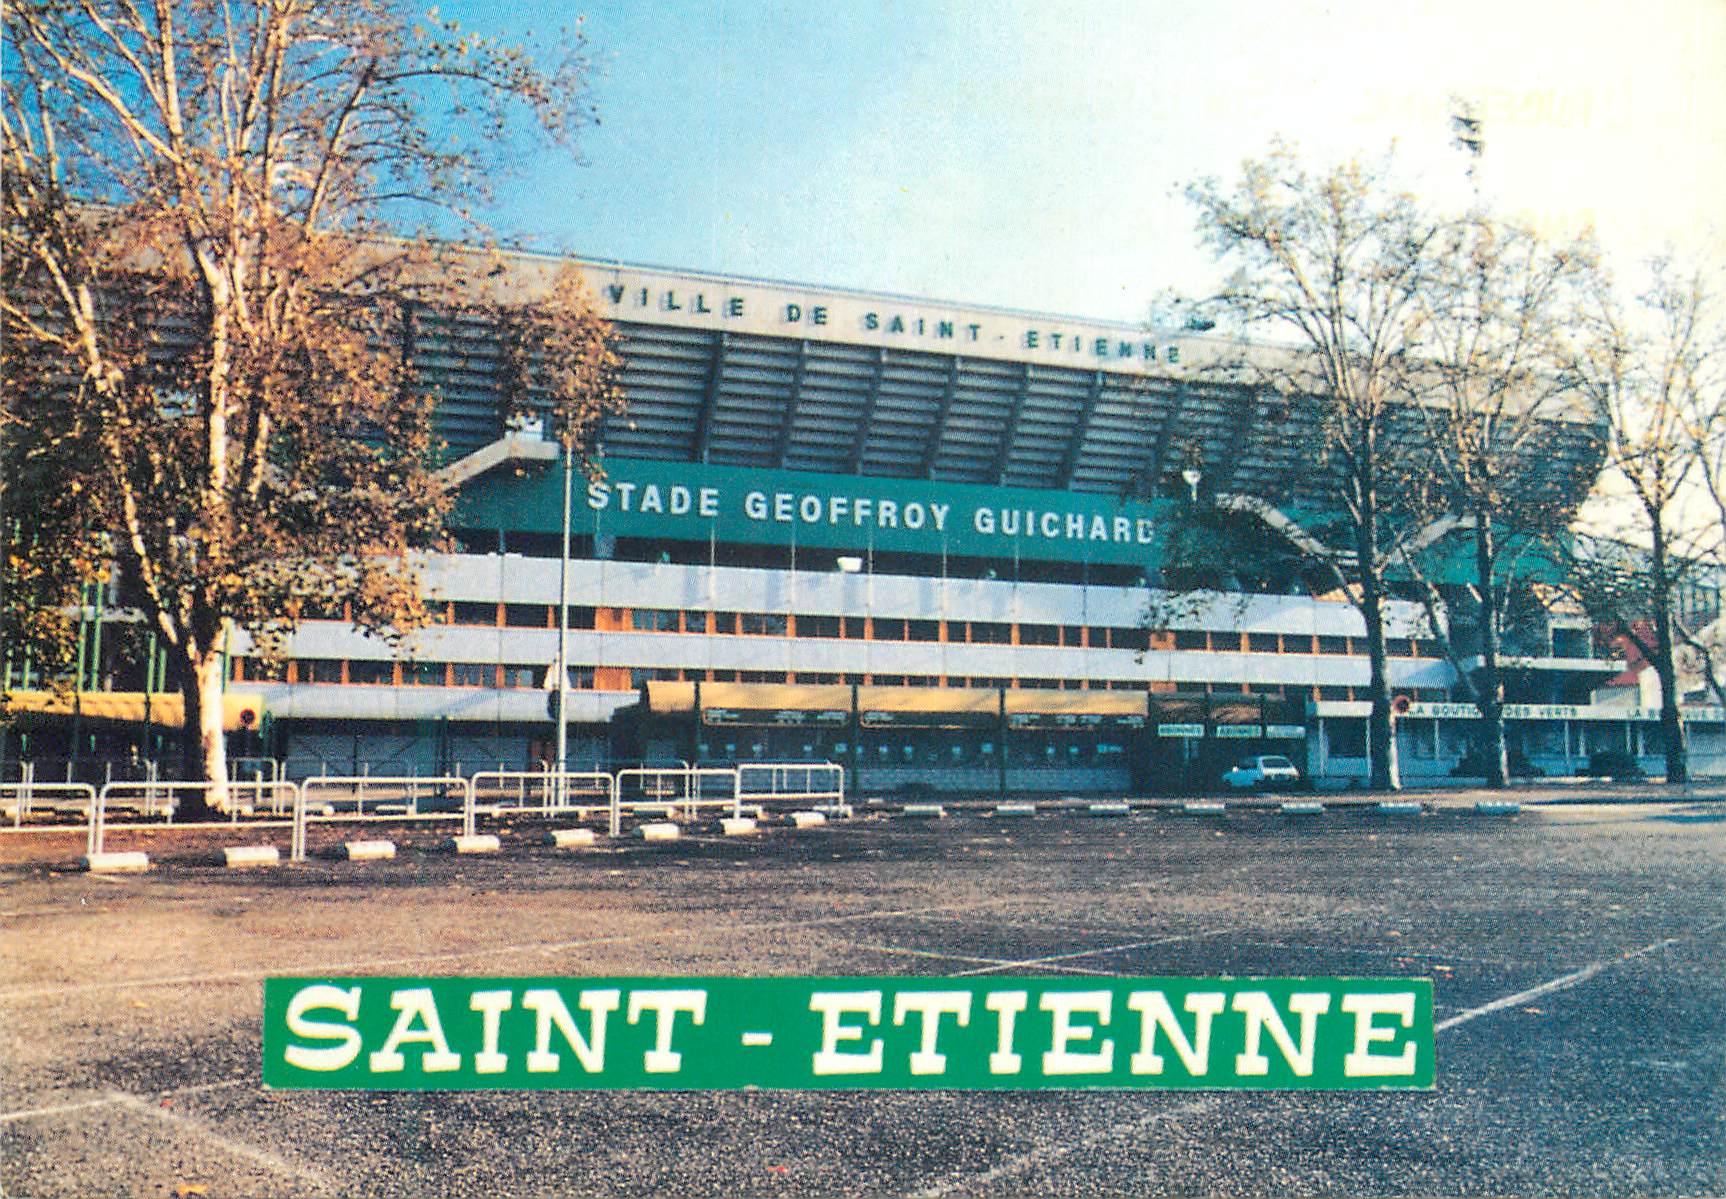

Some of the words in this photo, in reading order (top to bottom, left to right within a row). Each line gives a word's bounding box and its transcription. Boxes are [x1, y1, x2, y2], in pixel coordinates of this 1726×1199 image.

[608, 284, 744, 317] VILLE
[785, 303, 828, 326] DE
[864, 312, 981, 342] SAINT
[1026, 329, 1180, 364] ETIENNE
[586, 482, 720, 518] STADE
[744, 491, 951, 532] GEOFFROY
[973, 507, 1154, 545] GUICHARD
